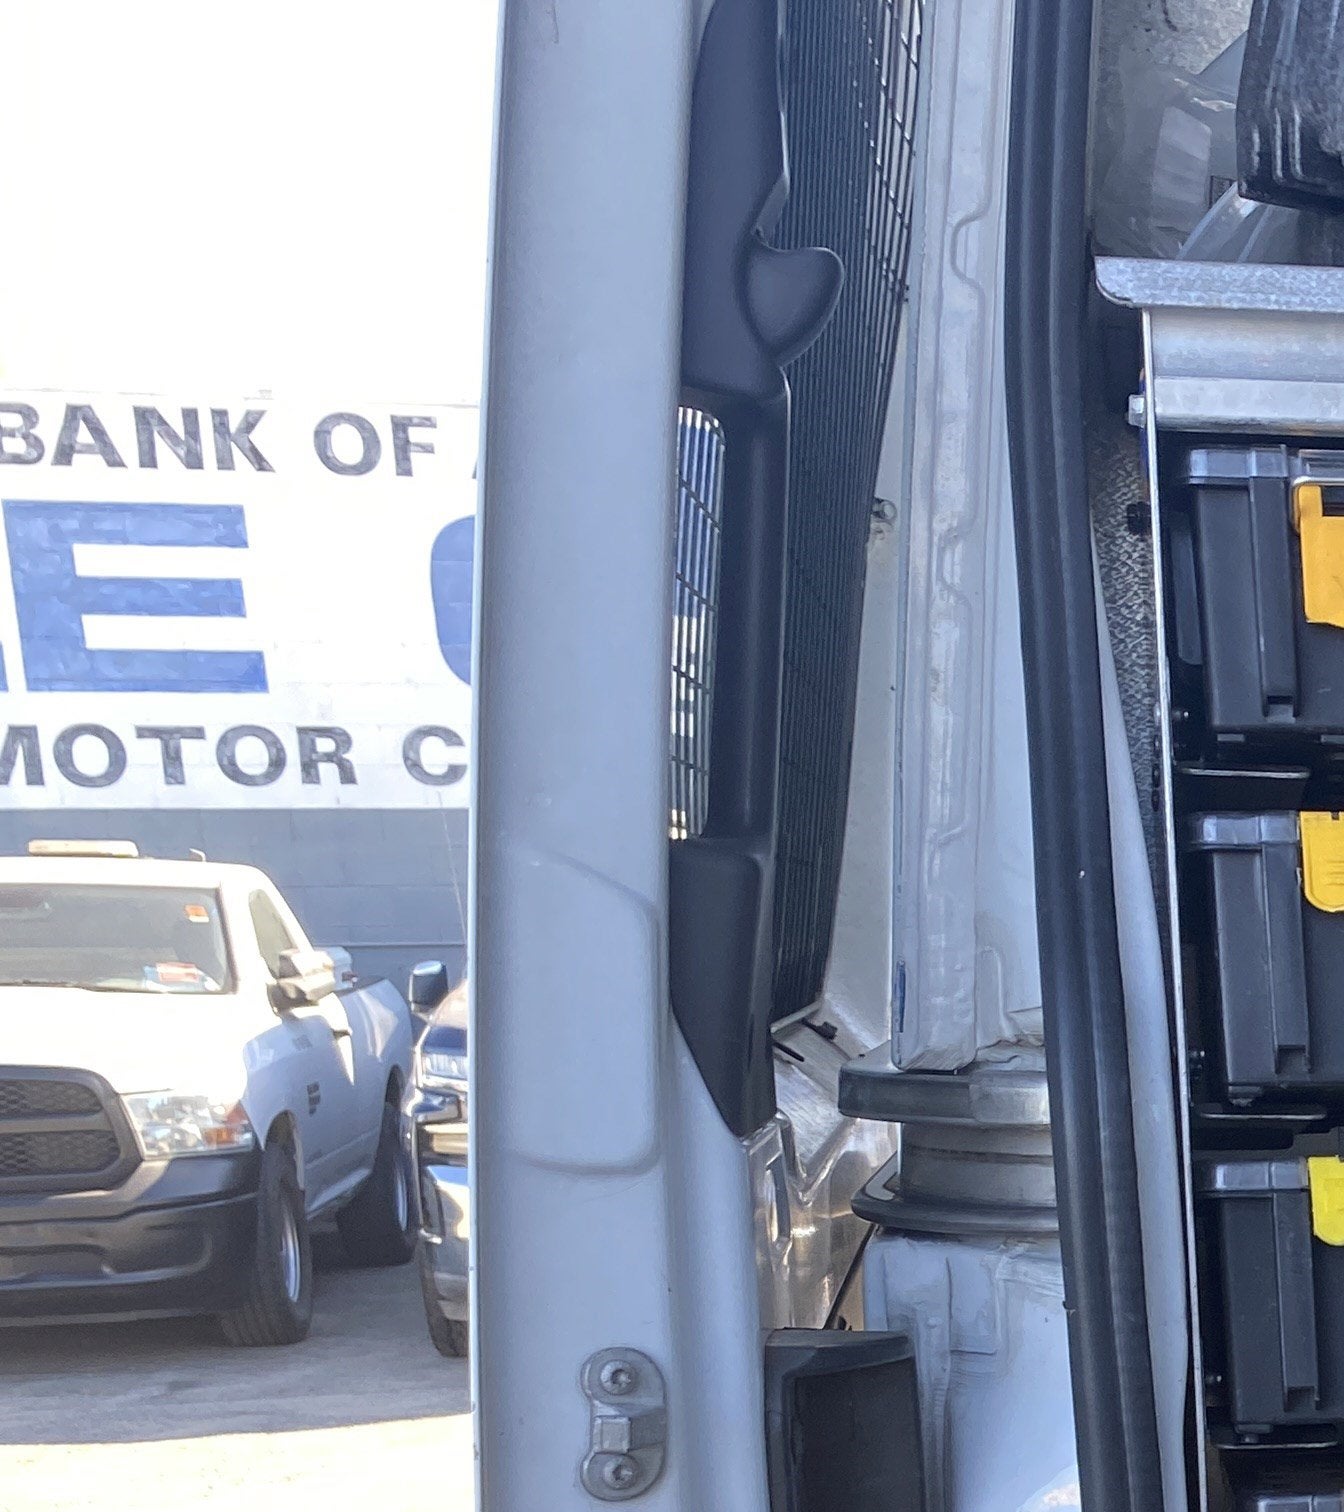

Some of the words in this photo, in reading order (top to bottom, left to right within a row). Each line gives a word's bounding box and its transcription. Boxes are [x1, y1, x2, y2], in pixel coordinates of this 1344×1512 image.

[0, 402, 275, 473] BANK
[313, 412, 437, 477] OF
[0, 499, 269, 693] E
[0, 723, 358, 788] MOTOR
